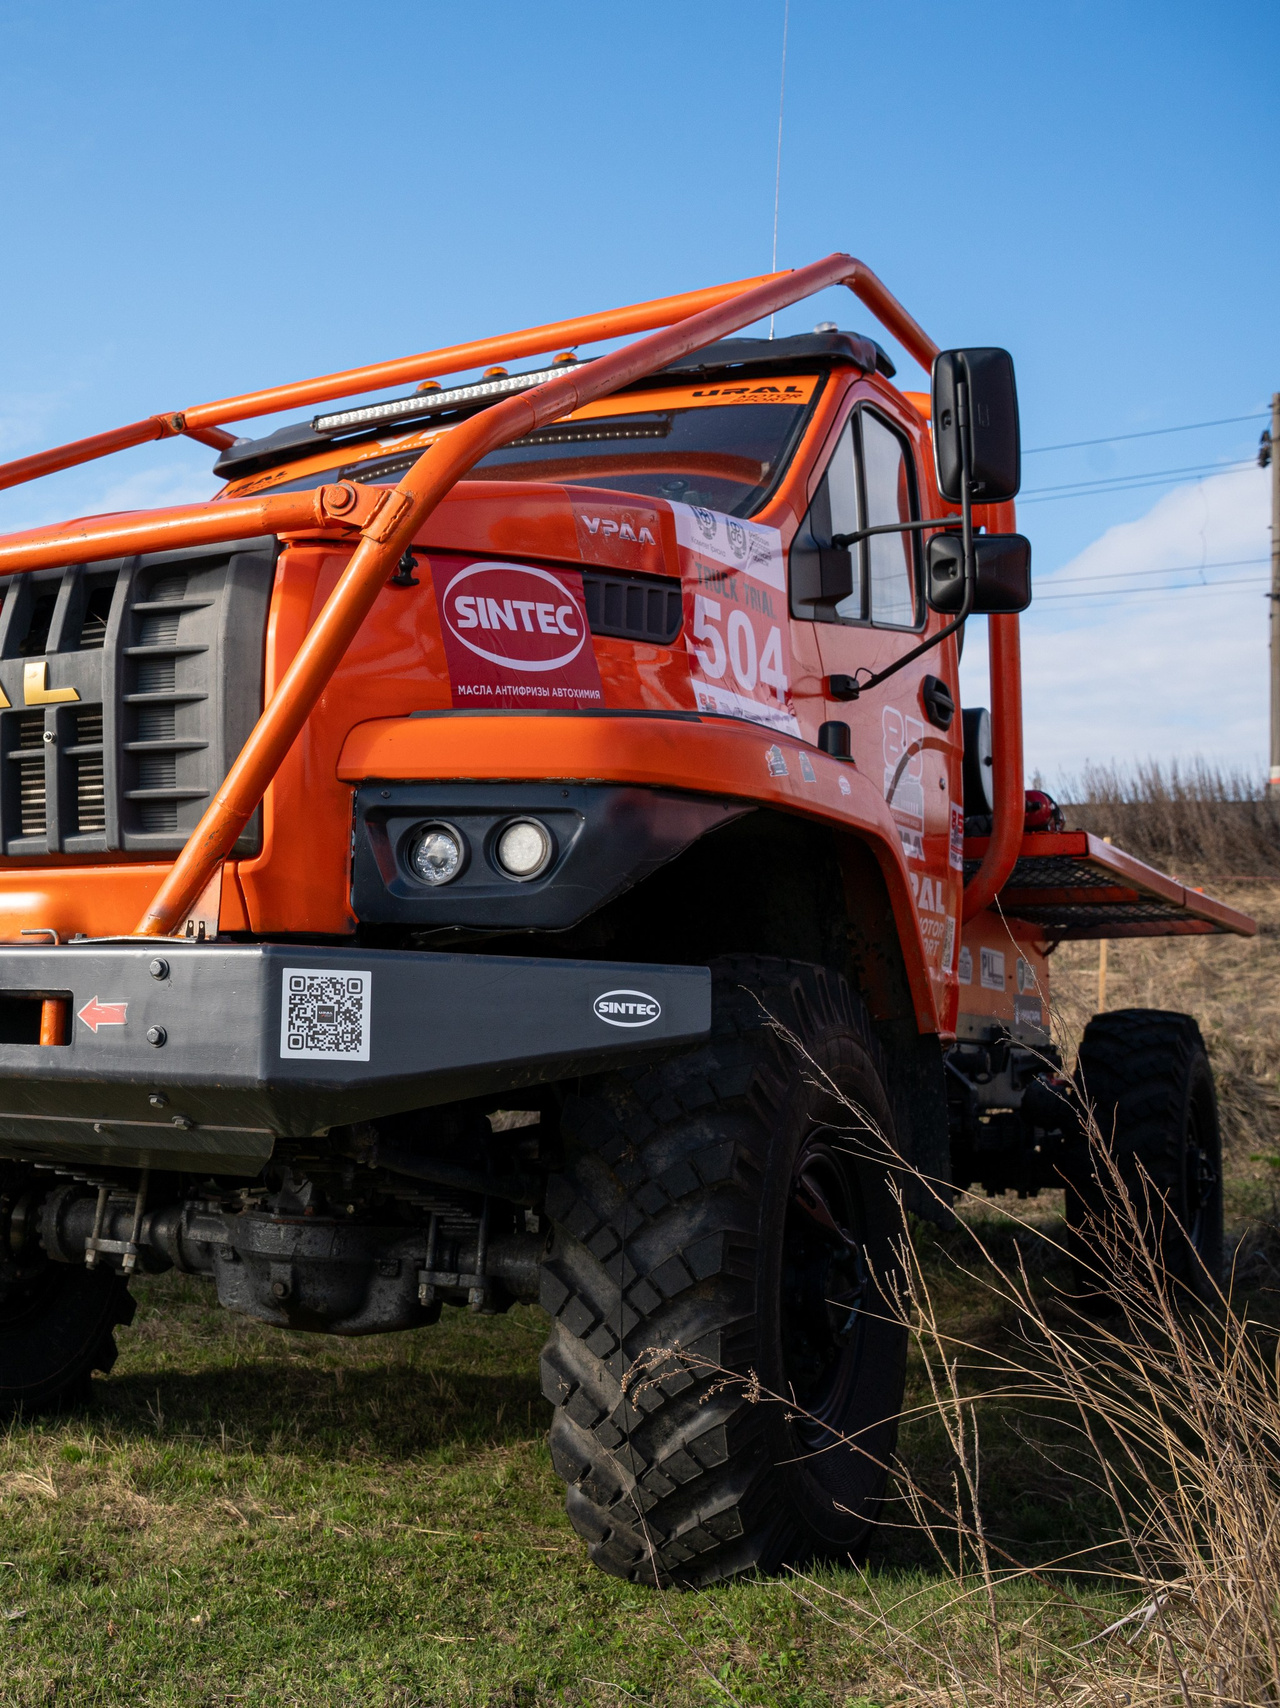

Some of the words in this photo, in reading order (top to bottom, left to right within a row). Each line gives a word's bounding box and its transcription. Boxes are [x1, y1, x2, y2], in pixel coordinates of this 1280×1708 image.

[692, 386, 804, 397] URAL
[581, 515, 657, 546] УРАЛ
[695, 561, 739, 603] TRUCK
[743, 582, 777, 620] TRIAL
[454, 595, 579, 637] SINTEC
[693, 593, 789, 705] 504
[458, 685, 493, 695] МАСЛА
[495, 685, 550, 697] АНТИФРИЗЫ
[552, 687, 601, 699] АВТОХИМИЯ
[920, 915, 945, 938] OTOR
[924, 937, 940, 957] ORT
[598, 1001, 657, 1017] SINTEC
